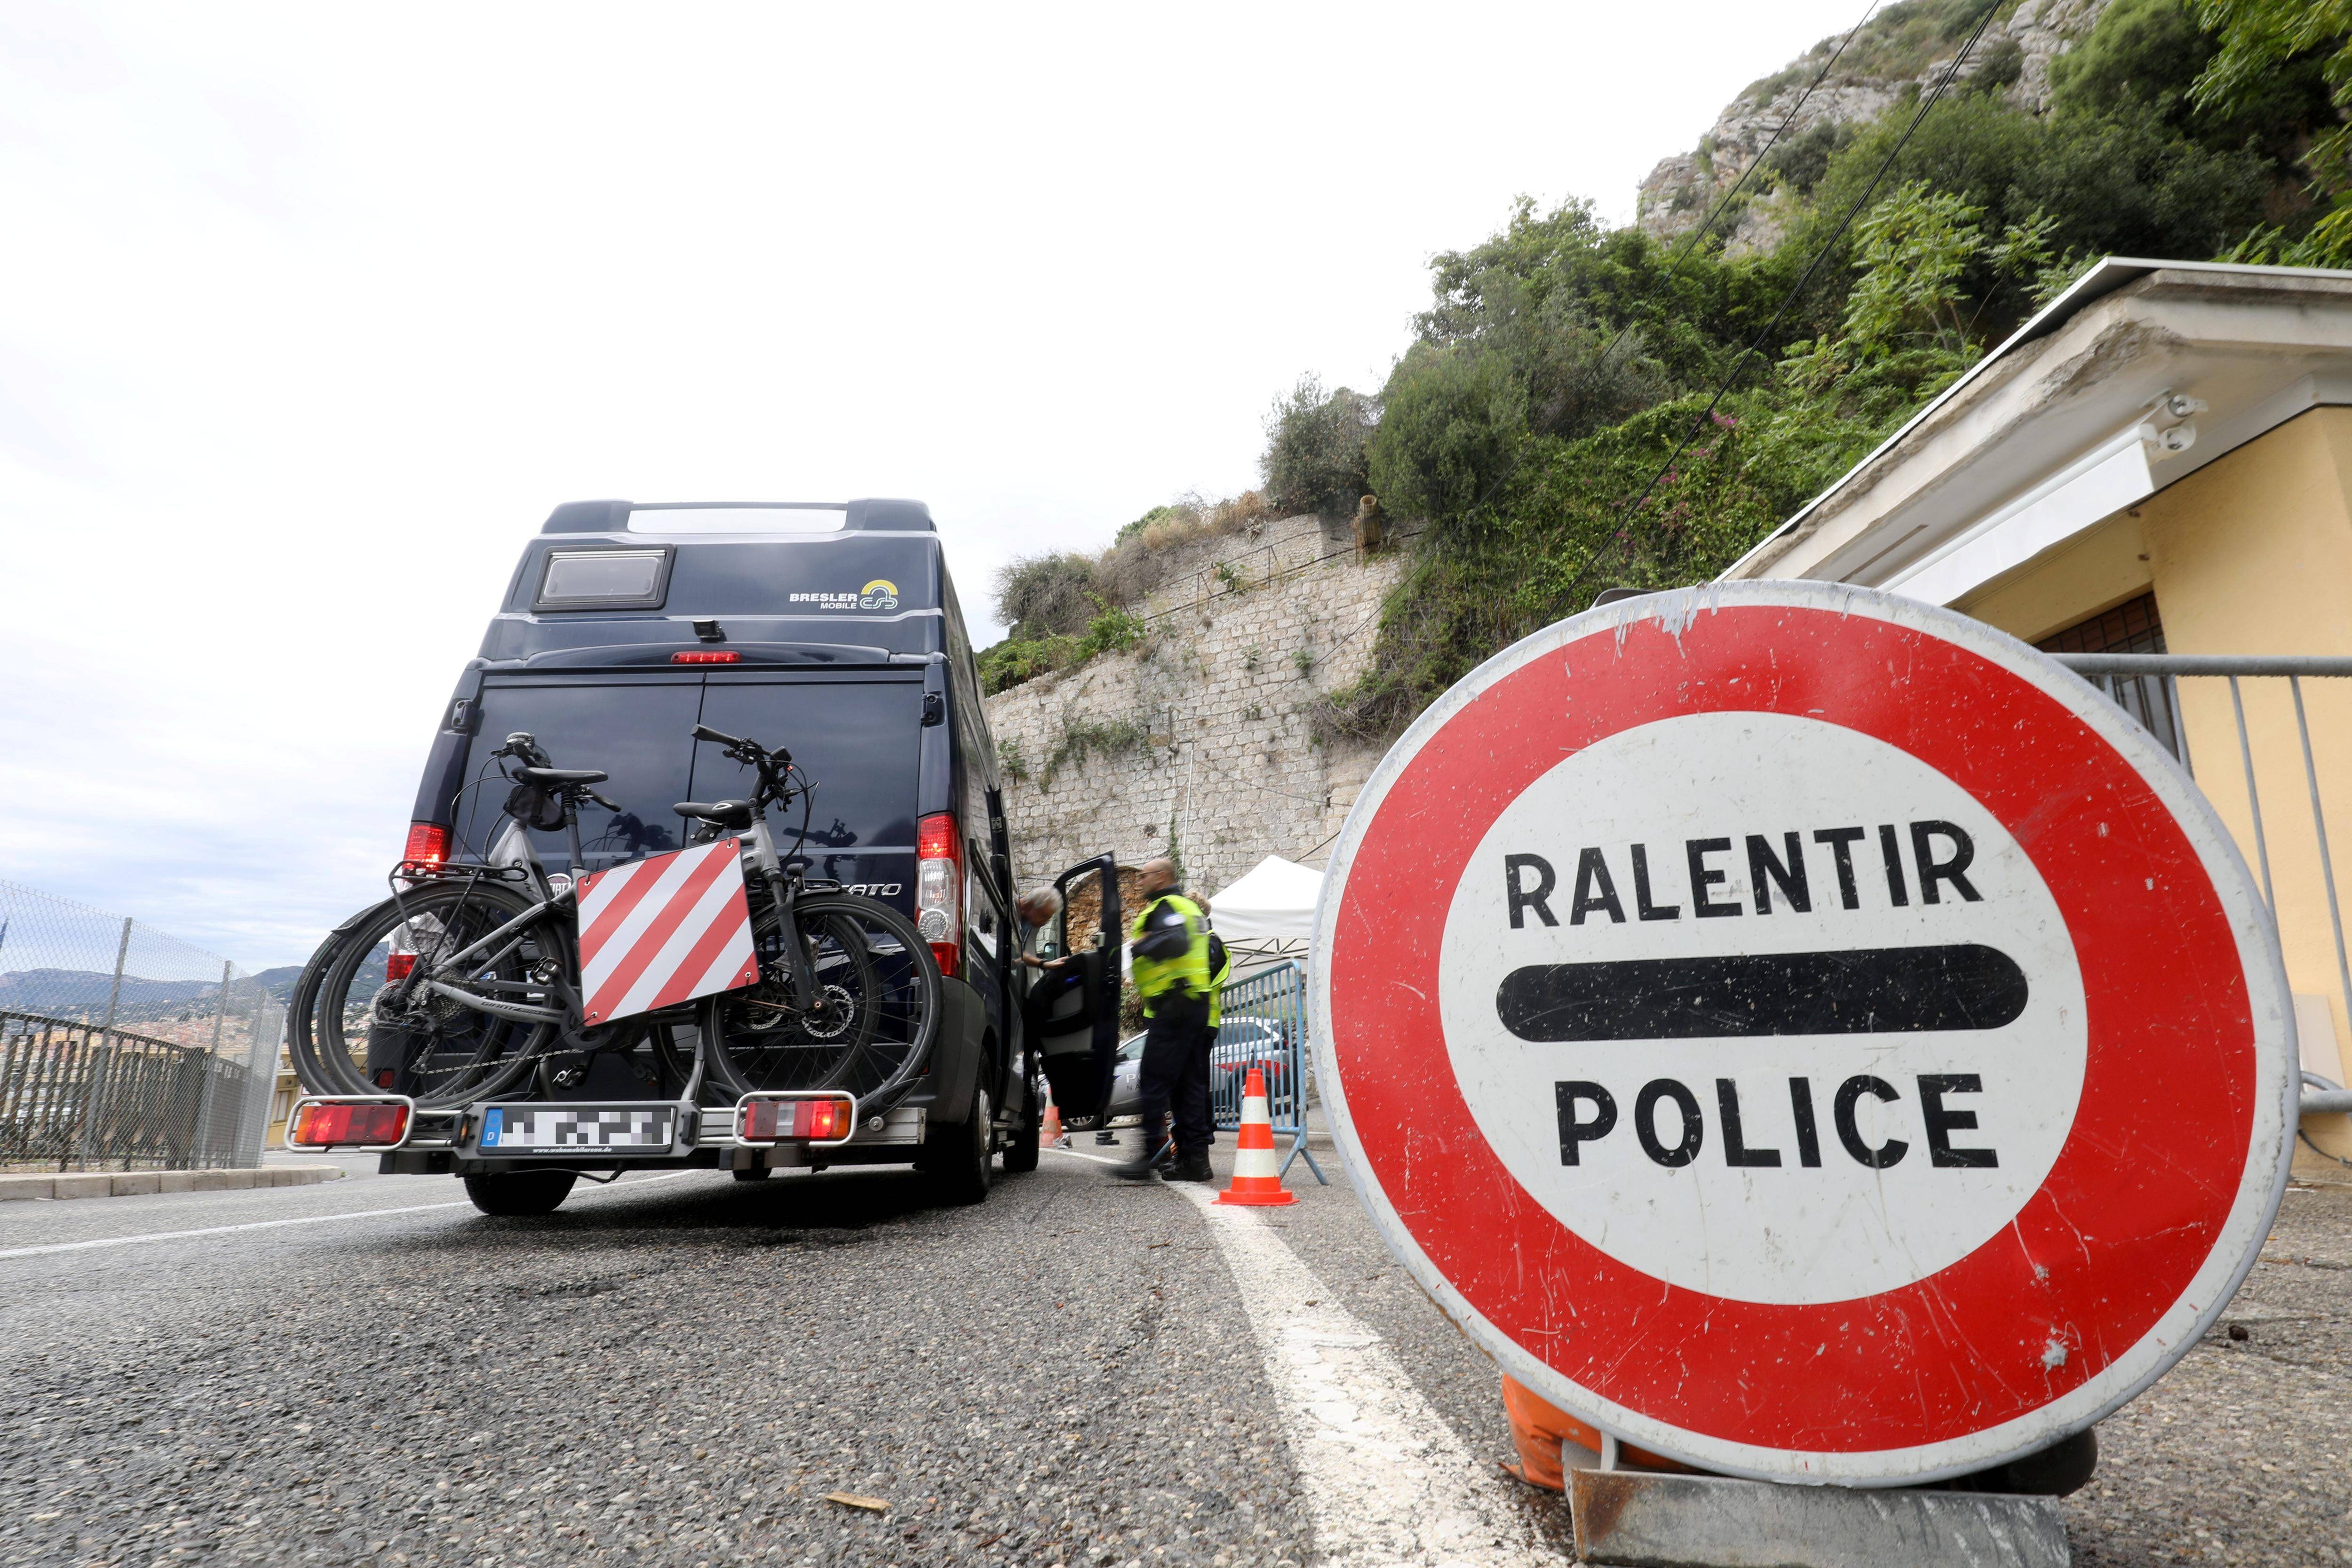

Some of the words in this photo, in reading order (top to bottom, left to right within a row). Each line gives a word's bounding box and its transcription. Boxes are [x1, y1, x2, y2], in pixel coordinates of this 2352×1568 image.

[789, 593, 858, 602] BRESLER
[1505, 820, 1984, 929] RALENTIR
[549, 883, 567, 897] IAT
[842, 883, 902, 896] ATO
[1555, 1074, 1999, 1168] POLICE
[487, 1132, 495, 1141] D
